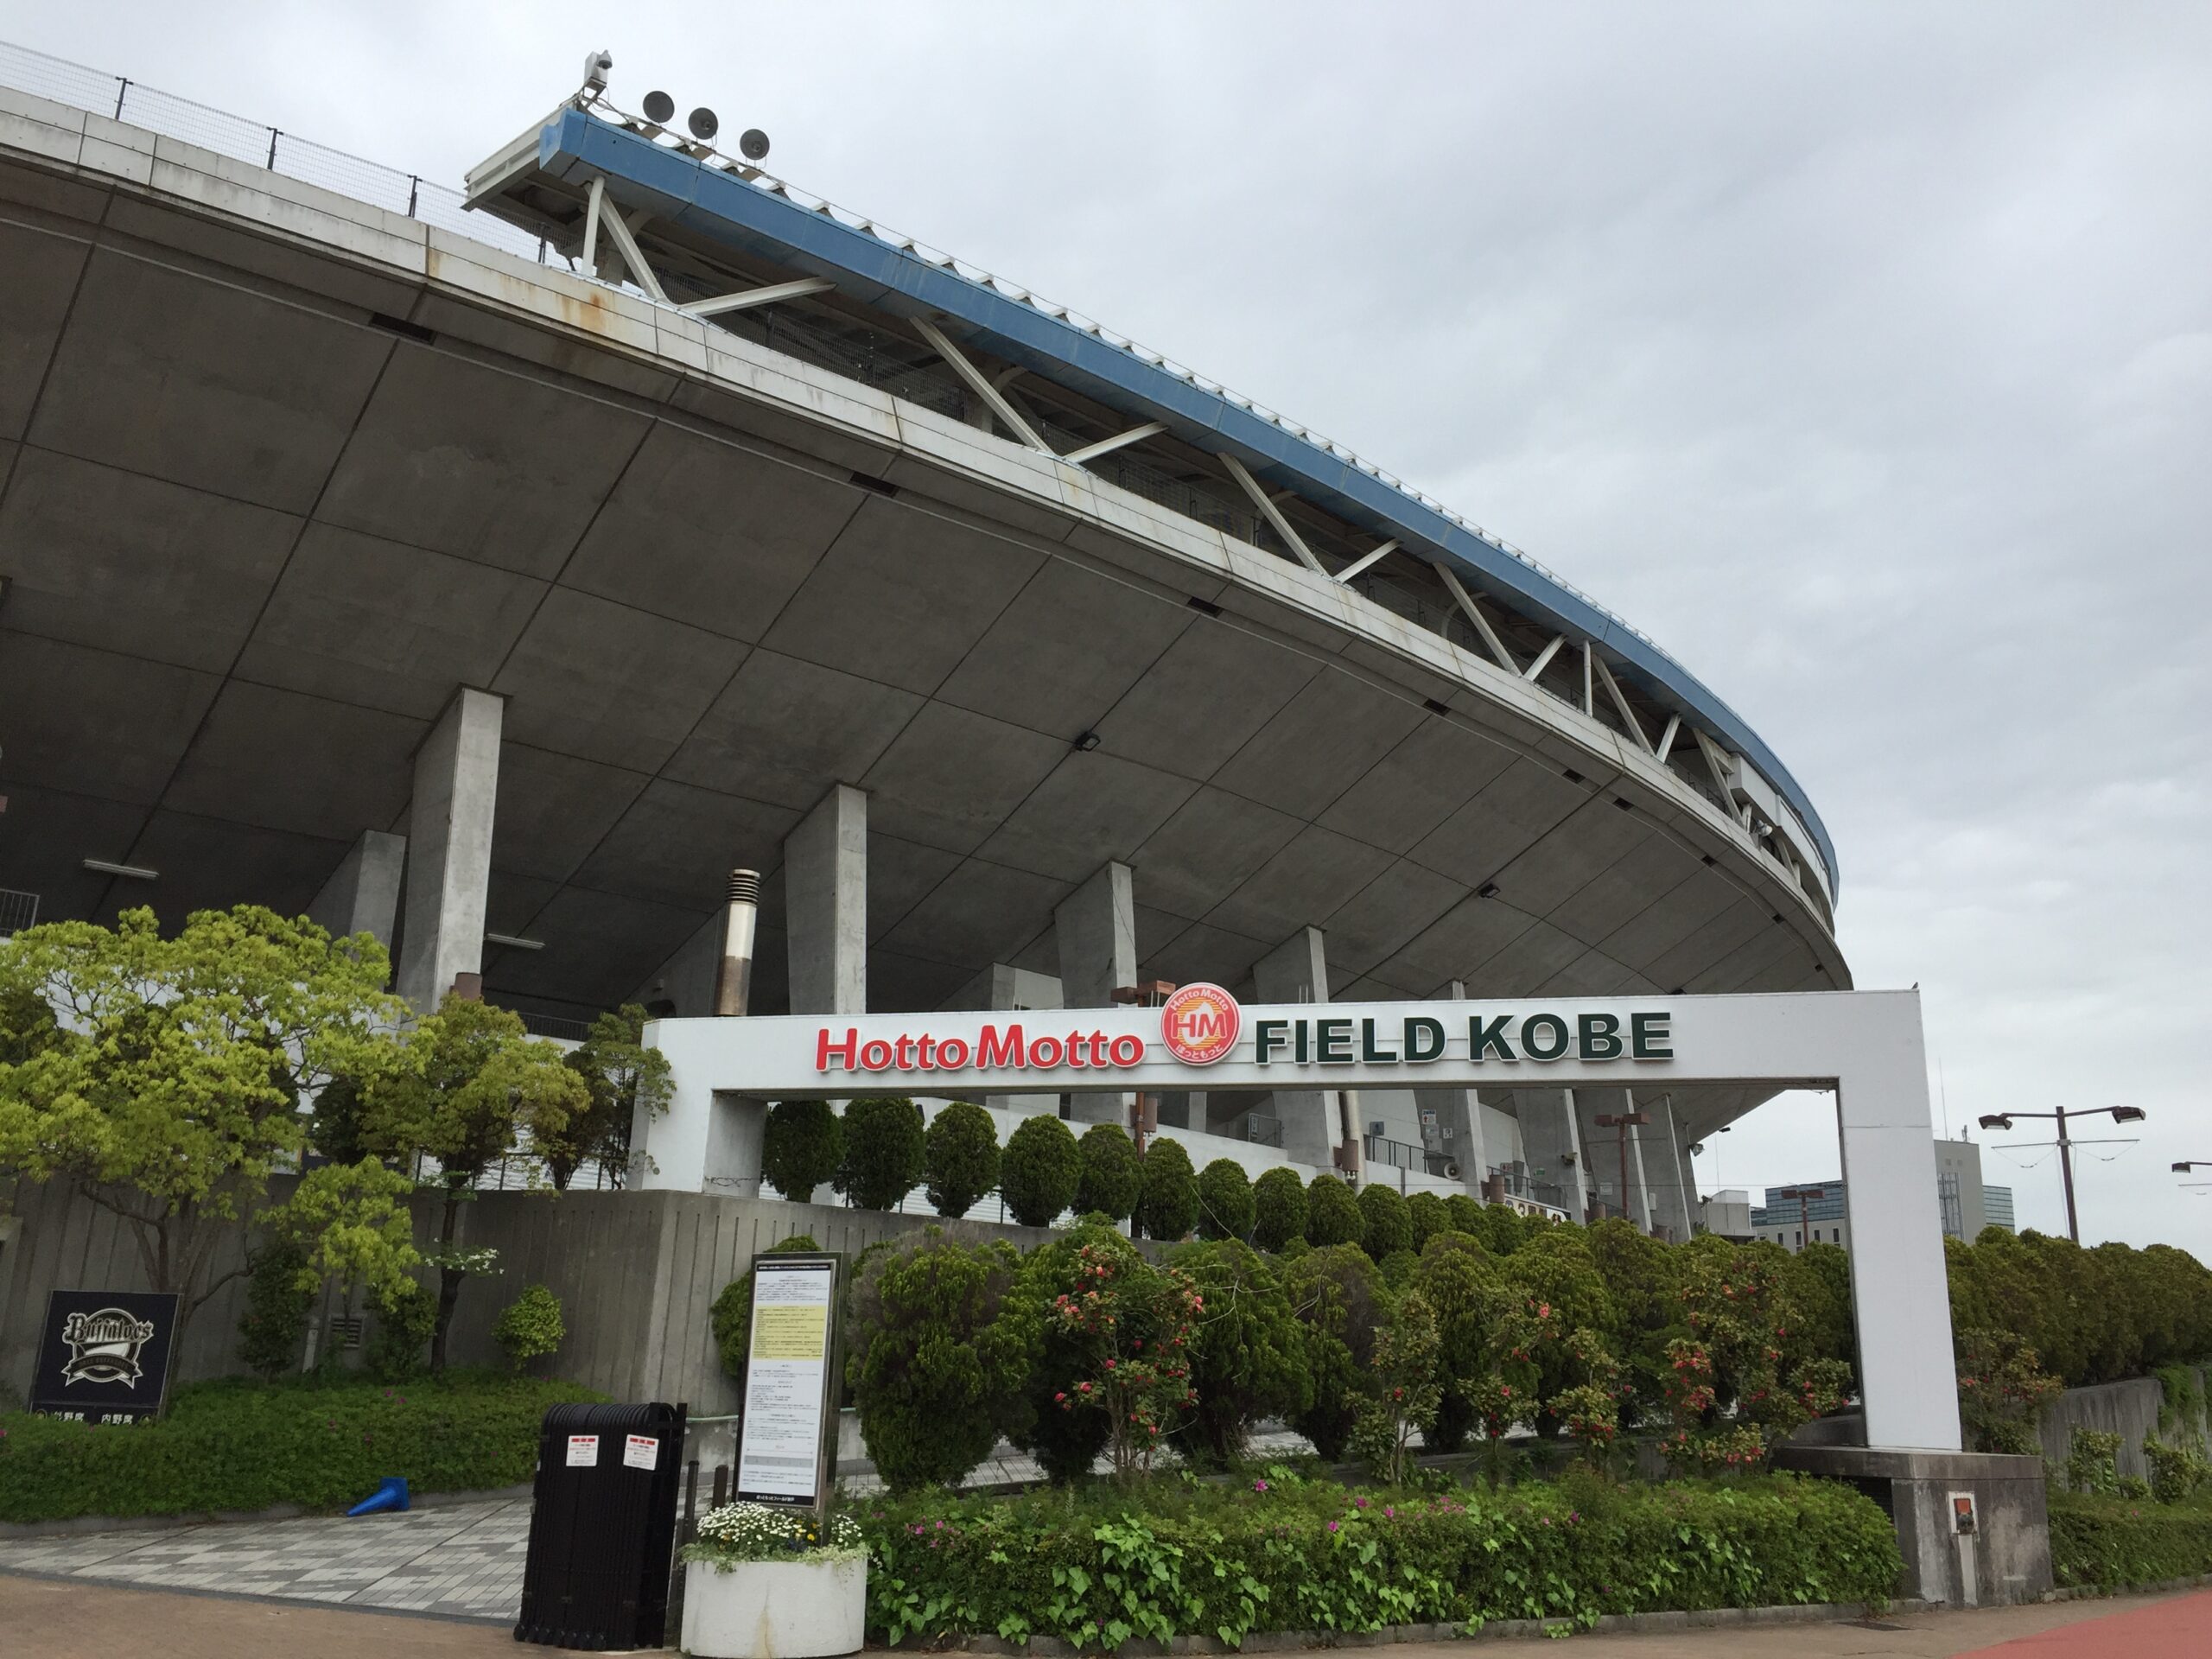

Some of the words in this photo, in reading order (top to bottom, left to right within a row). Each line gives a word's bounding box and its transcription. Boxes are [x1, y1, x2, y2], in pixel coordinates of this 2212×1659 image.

[1170, 1013, 1228, 1039] HM
[1255, 1017, 1446, 1065] FIELD
[1468, 1012, 1675, 1063] KOBE
[1176, 1044, 1223, 1058] ほっともっと
